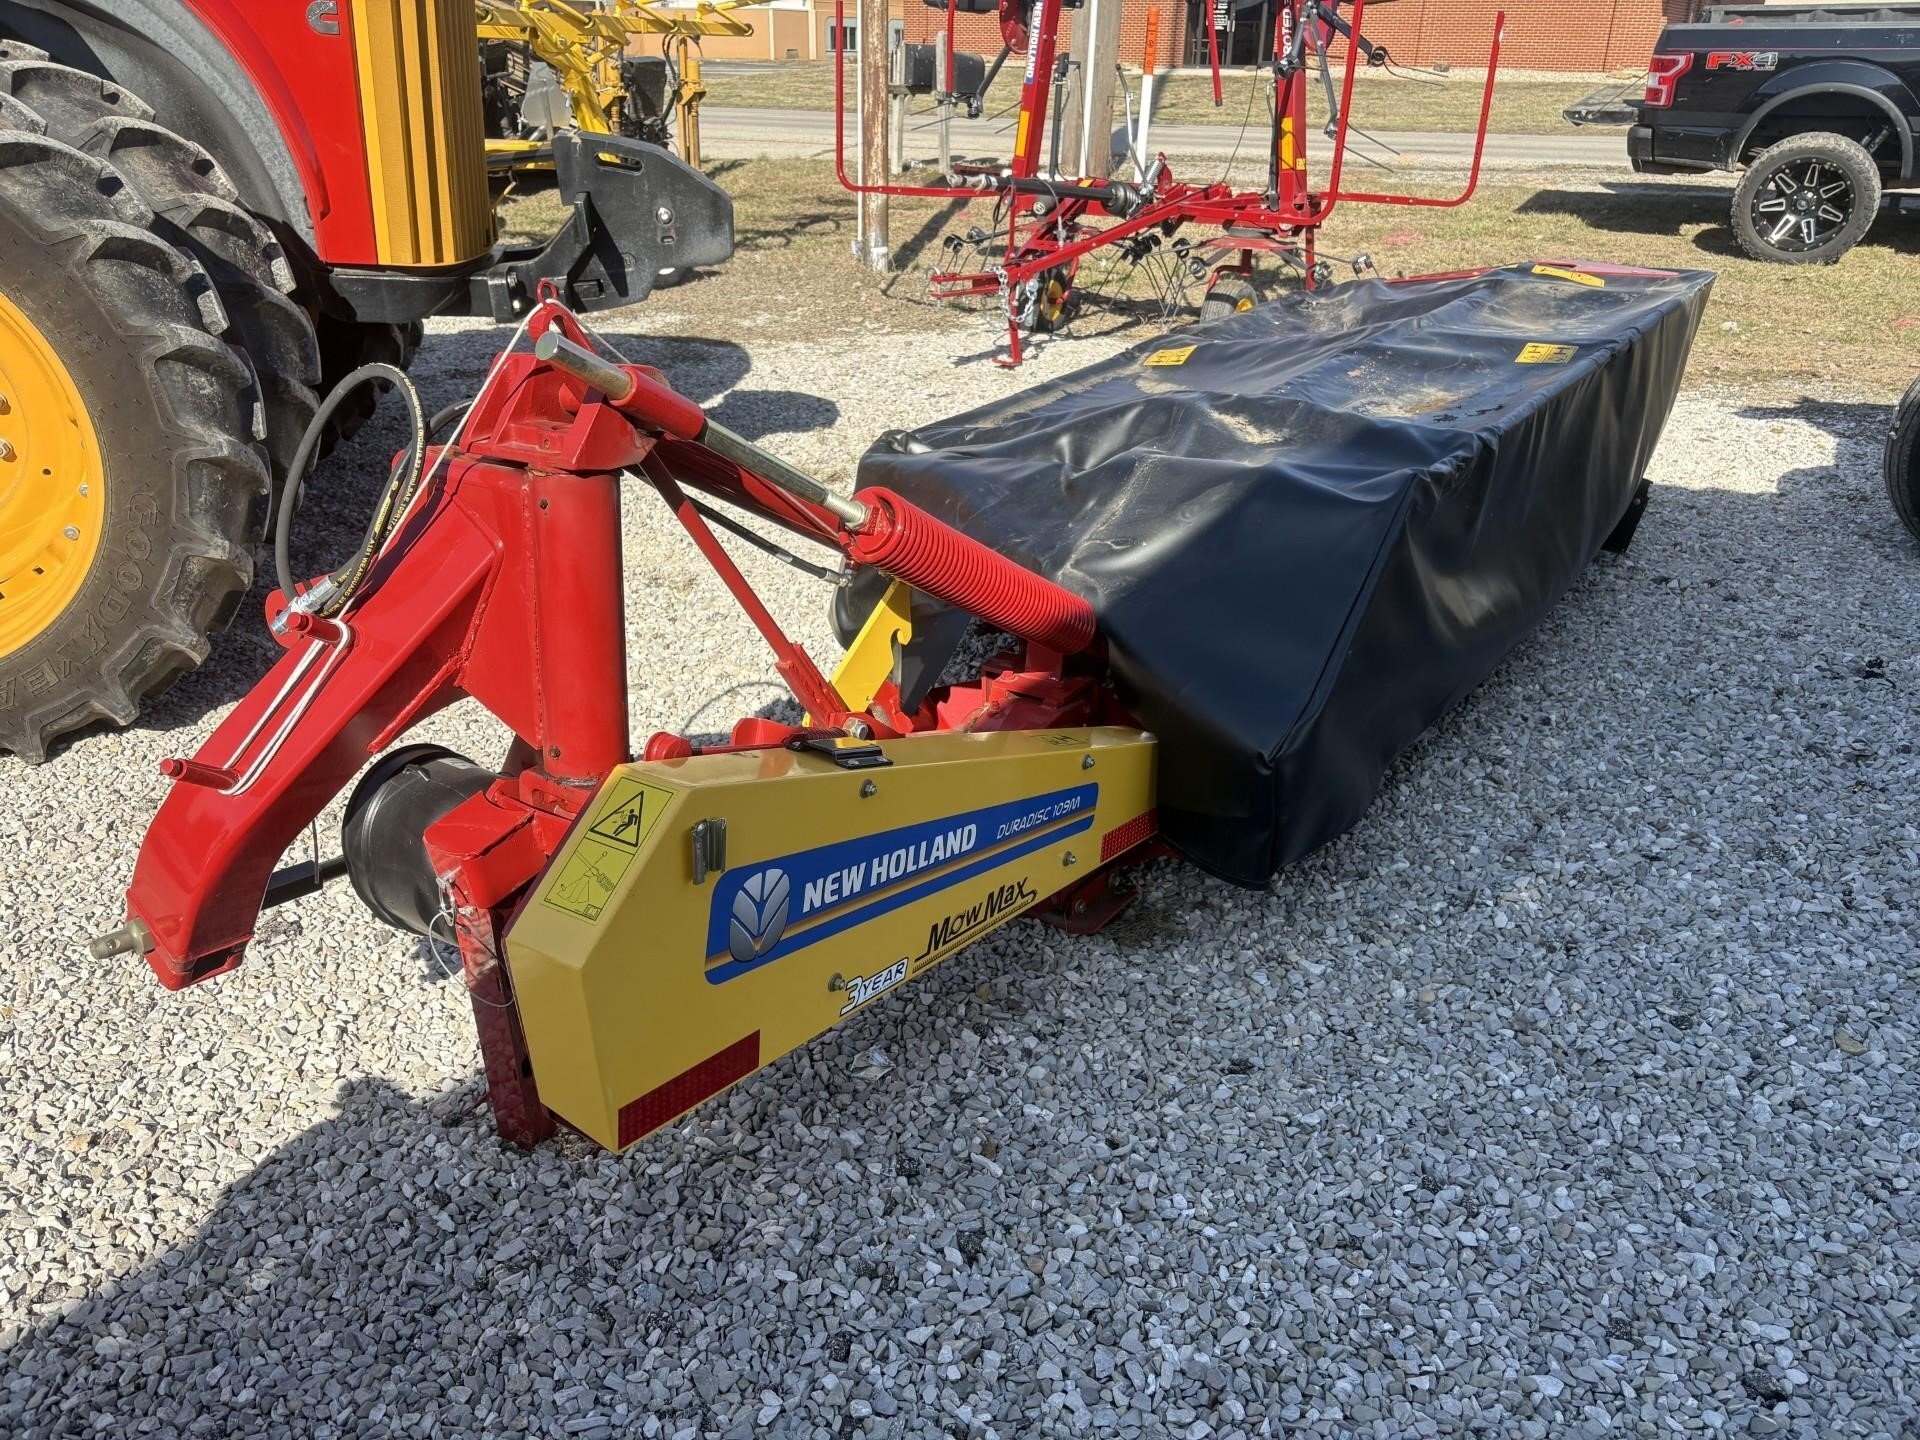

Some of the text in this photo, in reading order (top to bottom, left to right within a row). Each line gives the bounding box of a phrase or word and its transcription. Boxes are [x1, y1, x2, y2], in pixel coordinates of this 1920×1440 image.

[1026, 1, 1043, 77] NEW HOLLAND
[1706, 52, 1778, 69] FX4
[345, 556, 368, 597] WEARGUARD
[996, 796, 1080, 839] DURADISC 109M
[802, 824, 977, 913] NEW HOLLAND
